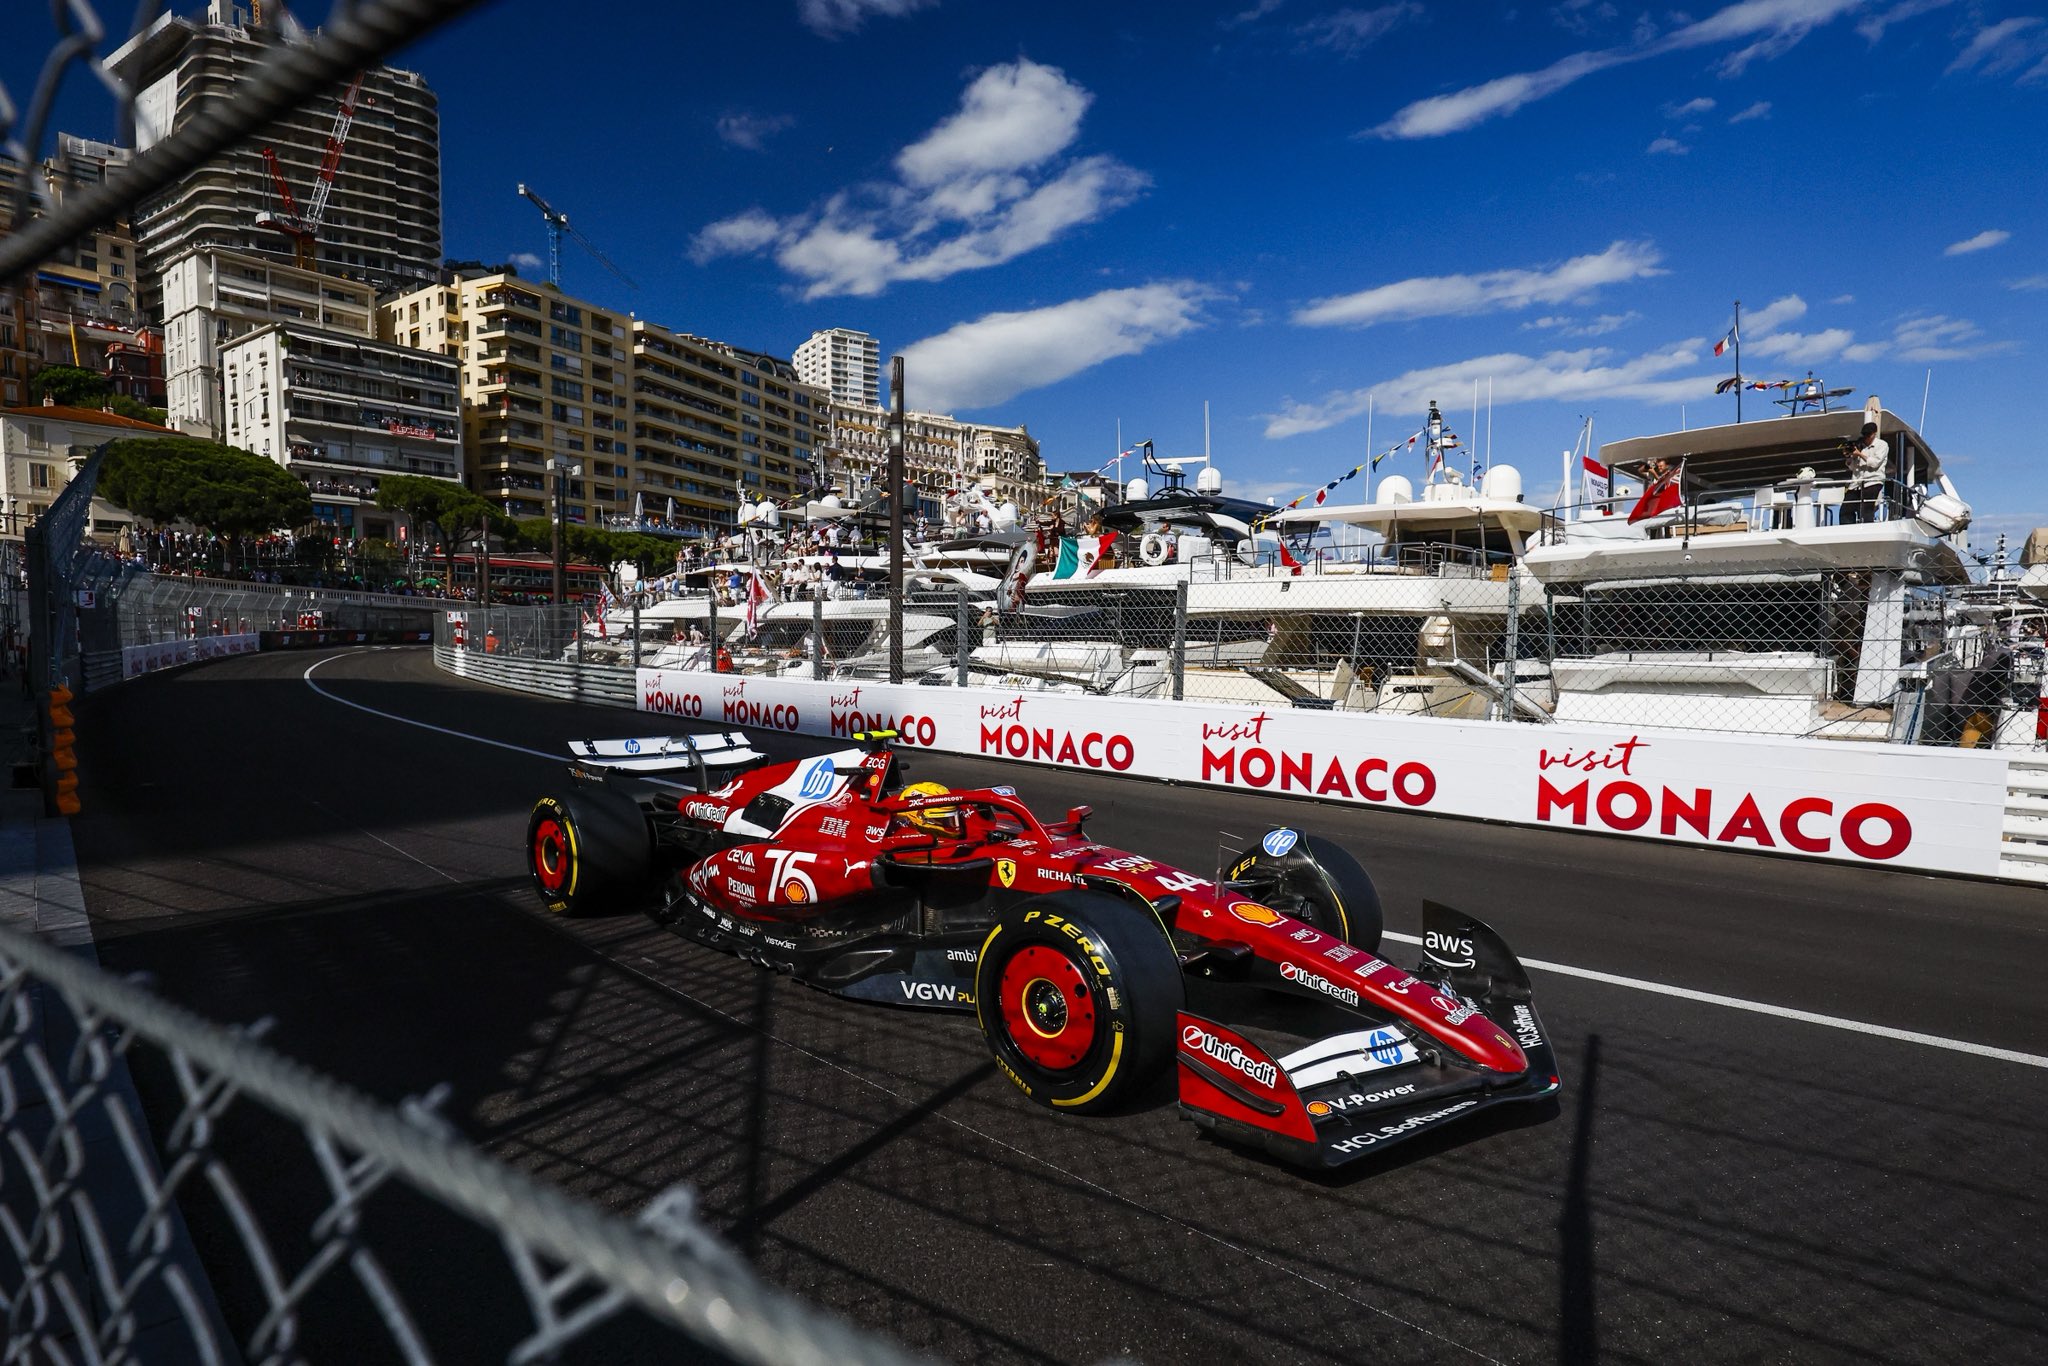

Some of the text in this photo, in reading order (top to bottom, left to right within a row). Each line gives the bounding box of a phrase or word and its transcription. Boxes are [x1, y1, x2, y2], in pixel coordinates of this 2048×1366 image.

[645, 673, 663, 689] visit
[723, 679, 747, 698] visit
[645, 691, 702, 718] MONACO
[830, 686, 862, 709] visit
[980, 695, 1028, 722] visit
[723, 700, 799, 732] MONACO
[831, 711, 936, 747] MONACO
[1202, 712, 1273, 744] visit
[626, 739, 640, 754] hp
[980, 722, 1134, 771] MONACO
[1539, 735, 1651, 776] visit
[866, 757, 886, 769] ZCG
[1202, 743, 1436, 807] MONACO
[801, 758, 834, 799] hp
[925, 796, 963, 804] TECHNOLOGY
[818, 816, 850, 838] IBM
[1537, 775, 1912, 860] MONACO
[1265, 830, 1296, 857] hp
[764, 849, 818, 903] 75
[1093, 854, 1153, 872] VGW
[727, 876, 756, 898] PERONI
[1154, 871, 1213, 892] 44
[1024, 911, 1111, 975] P ZERO
[1426, 931, 1474, 956] aws
[901, 981, 956, 1001] VGW
[1295, 969, 1359, 1007] UniCredit
[1202, 1033, 1277, 1089] UniCredit
[1371, 1031, 1402, 1065] hp
[1332, 1083, 1416, 1111] V-Power
[1332, 1100, 1479, 1154] HCLSoftware
